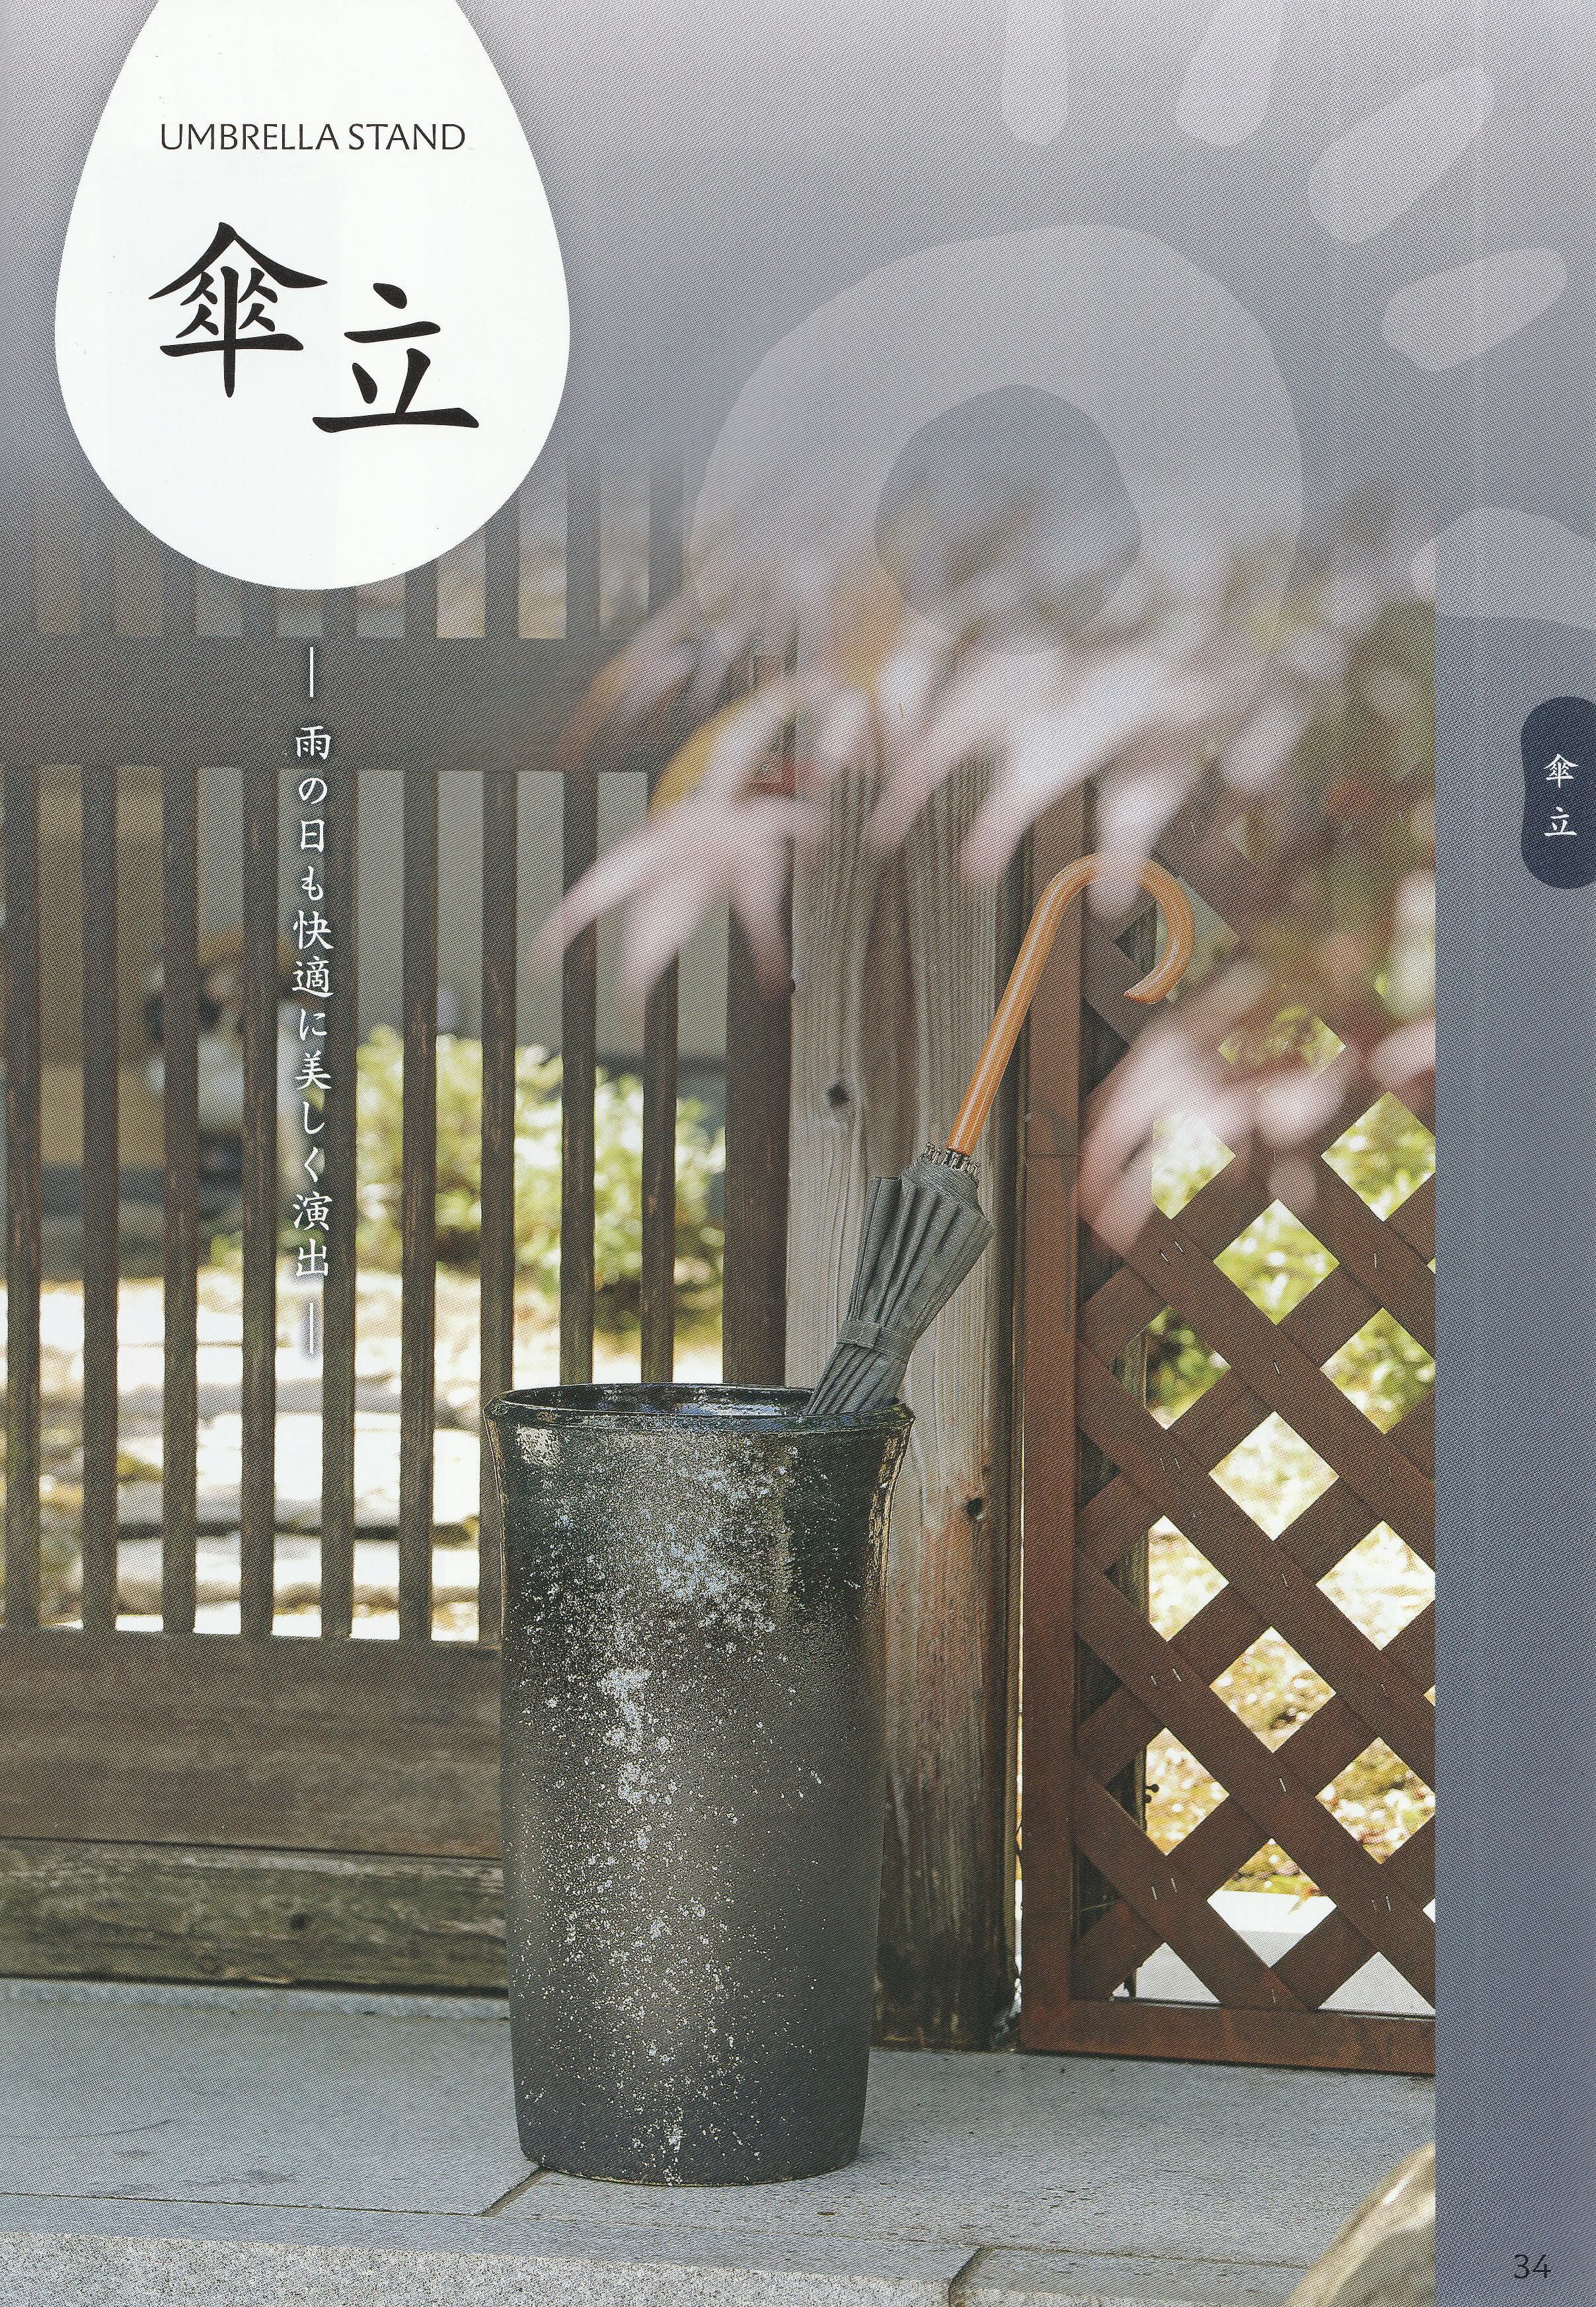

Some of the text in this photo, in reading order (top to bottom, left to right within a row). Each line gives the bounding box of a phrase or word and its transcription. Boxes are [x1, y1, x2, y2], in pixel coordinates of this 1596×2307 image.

[161, 123, 466, 151] UMBRELLA STAND
[148, 221, 480, 434] 傘立
[1543, 753, 1579, 837] 傘立
[1513, 2253, 1552, 2280] 34
